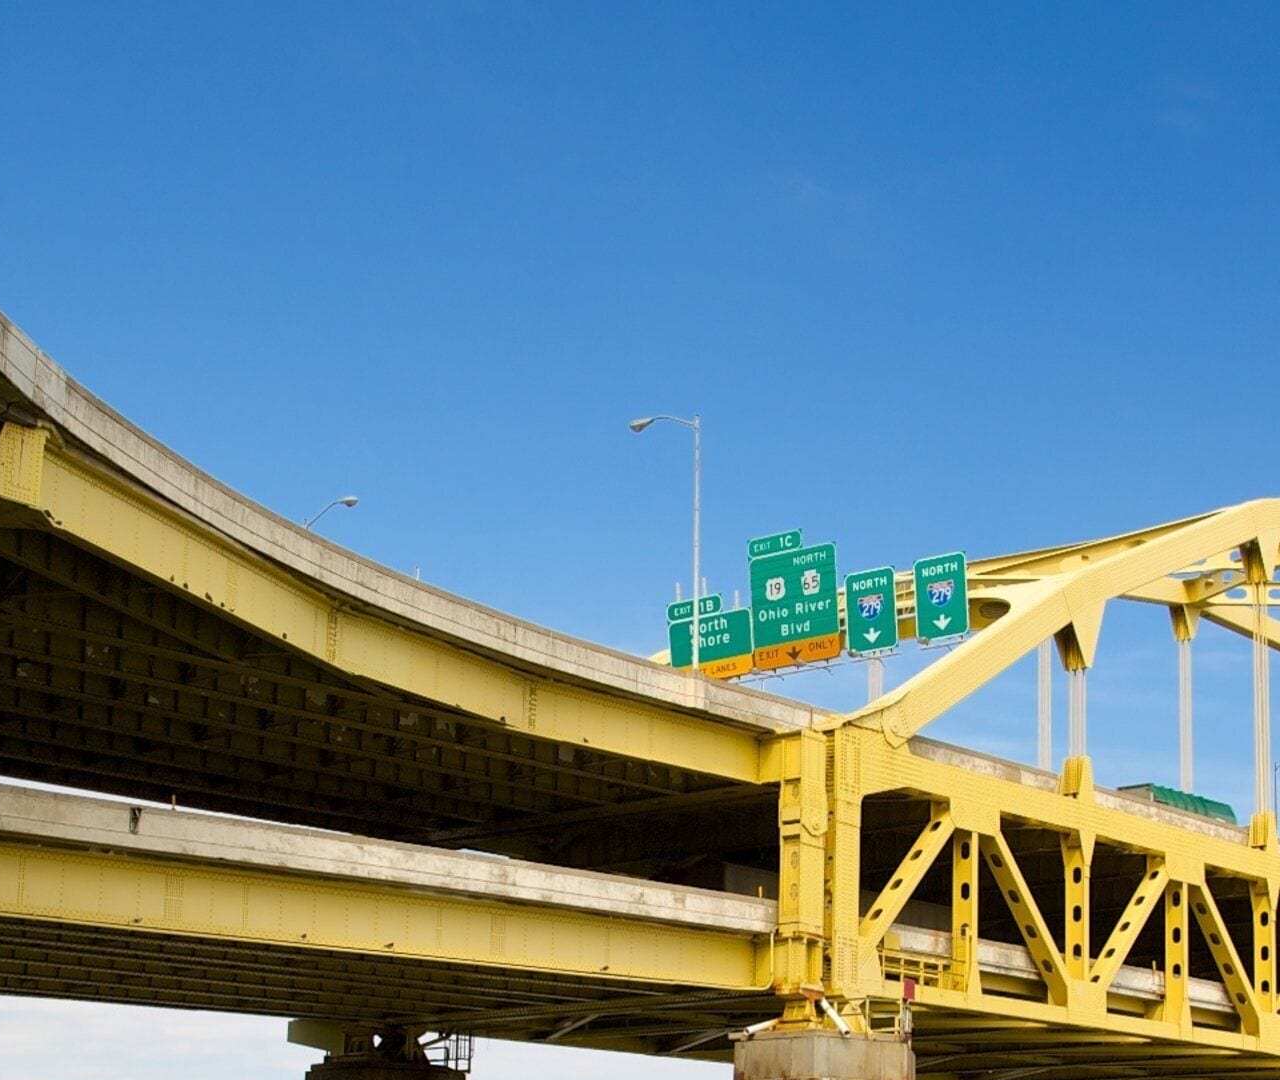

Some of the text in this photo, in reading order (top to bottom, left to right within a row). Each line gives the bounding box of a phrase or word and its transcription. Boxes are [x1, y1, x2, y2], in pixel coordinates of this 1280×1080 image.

[753, 535, 793, 552] EXIT 1C
[792, 551, 827, 566] NORTH
[922, 561, 958, 578] NORTH
[769, 582, 781, 596] 19
[803, 575, 819, 590] 65
[852, 576, 887, 592] NORTH
[932, 586, 952, 604] 279
[674, 600, 714, 617] EXIT 1B
[758, 599, 831, 622] Ohio River
[862, 600, 881, 618] 279
[780, 620, 810, 636] Blvd
[691, 633, 730, 648] hore
[758, 638, 834, 661] EXIT ONLY
